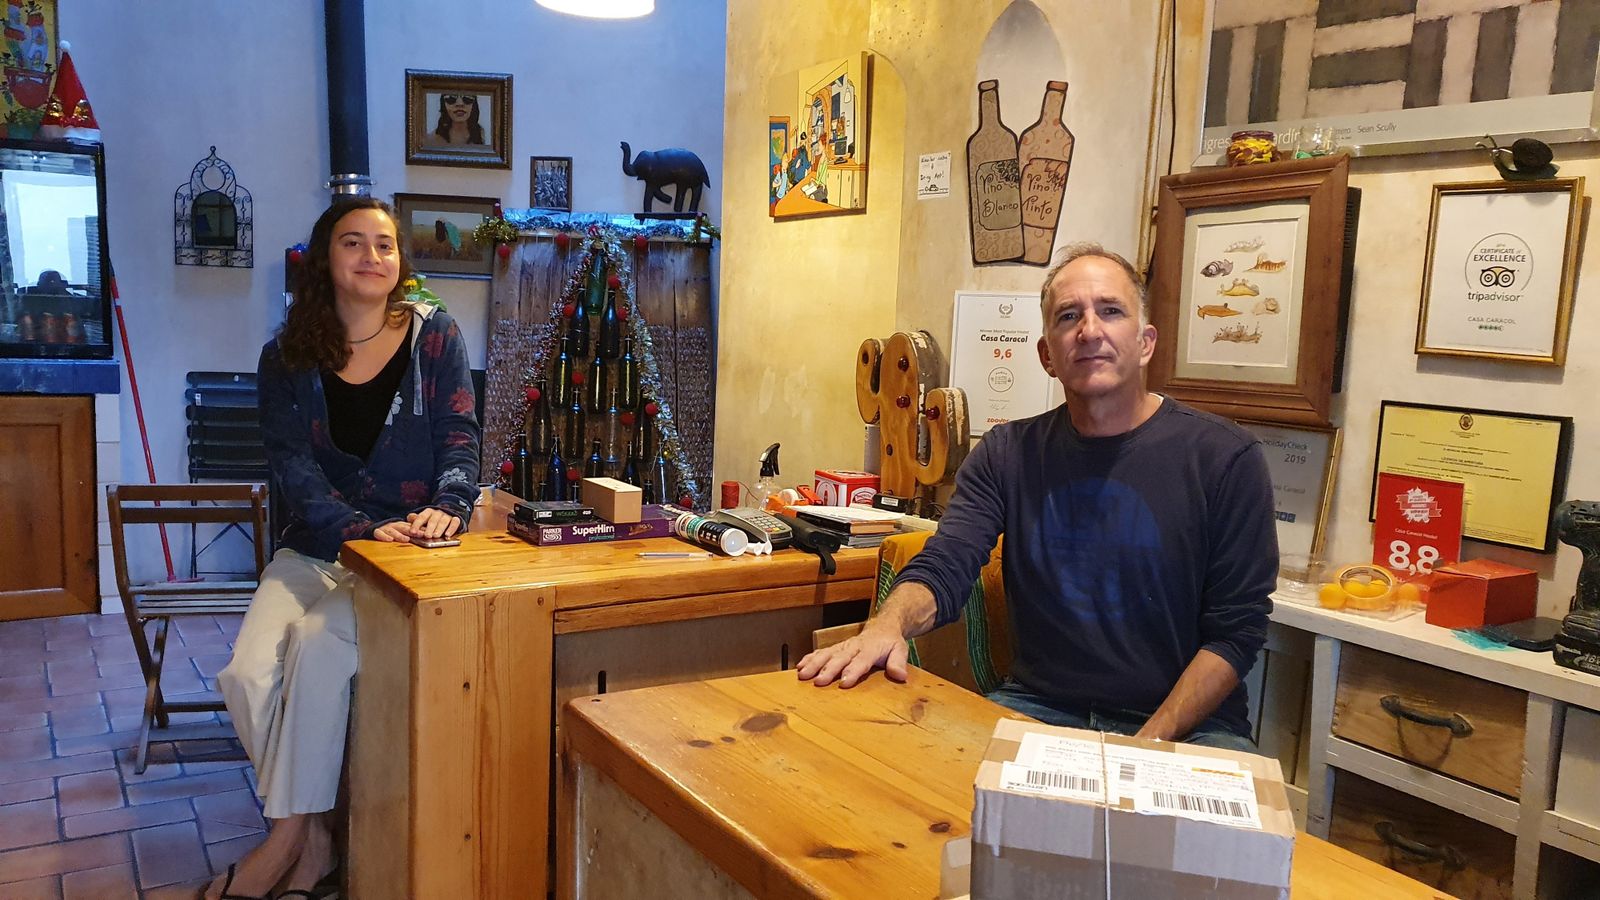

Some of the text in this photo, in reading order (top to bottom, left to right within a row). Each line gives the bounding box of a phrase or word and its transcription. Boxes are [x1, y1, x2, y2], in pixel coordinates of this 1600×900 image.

[1358, 125, 1375, 134] Sean
[1376, 122, 1397, 132] Scully
[982, 199, 1019, 217] Blanco
[1473, 254, 1527, 263] EXCELLENCE
[1467, 291, 1521, 303] tripadvisor
[1486, 317, 1517, 325] CARACOL
[980, 334, 1029, 343] Casa Caracol
[993, 348, 1013, 360] 9,6
[1284, 453, 1307, 464] 2019
[1388, 540, 1440, 576] 8,8
